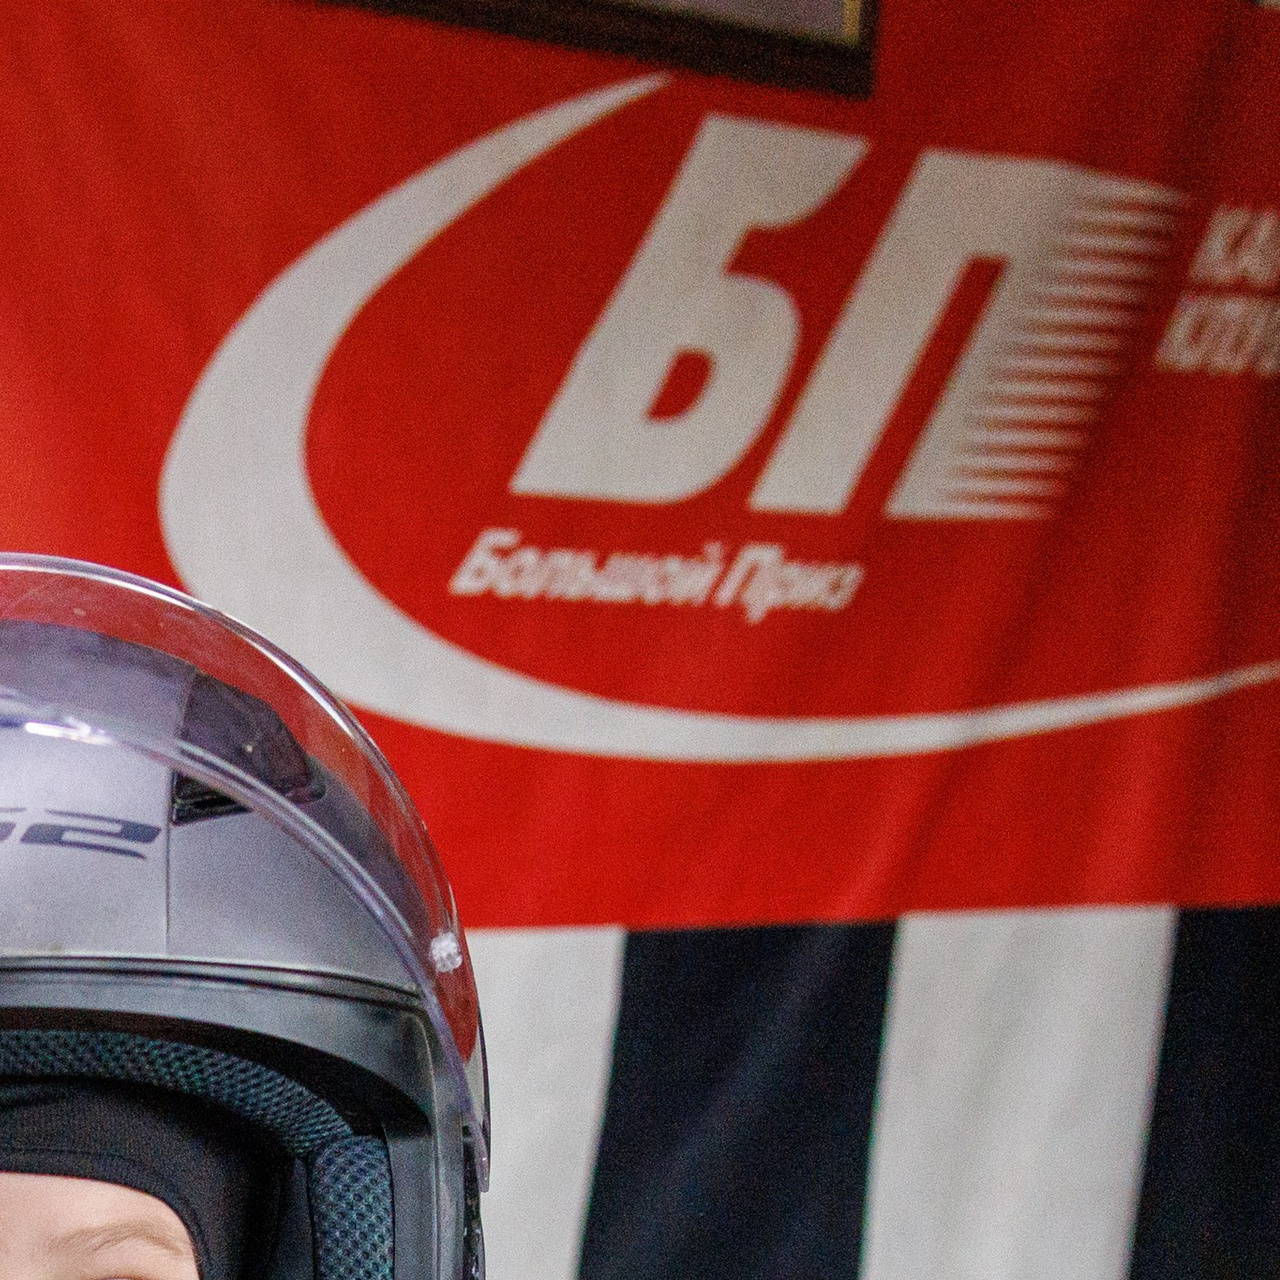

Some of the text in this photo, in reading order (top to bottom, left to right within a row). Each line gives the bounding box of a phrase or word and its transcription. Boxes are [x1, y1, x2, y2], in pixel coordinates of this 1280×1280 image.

[510, 113, 1190, 520] БП
[449, 528, 866, 624] Большой Приз
